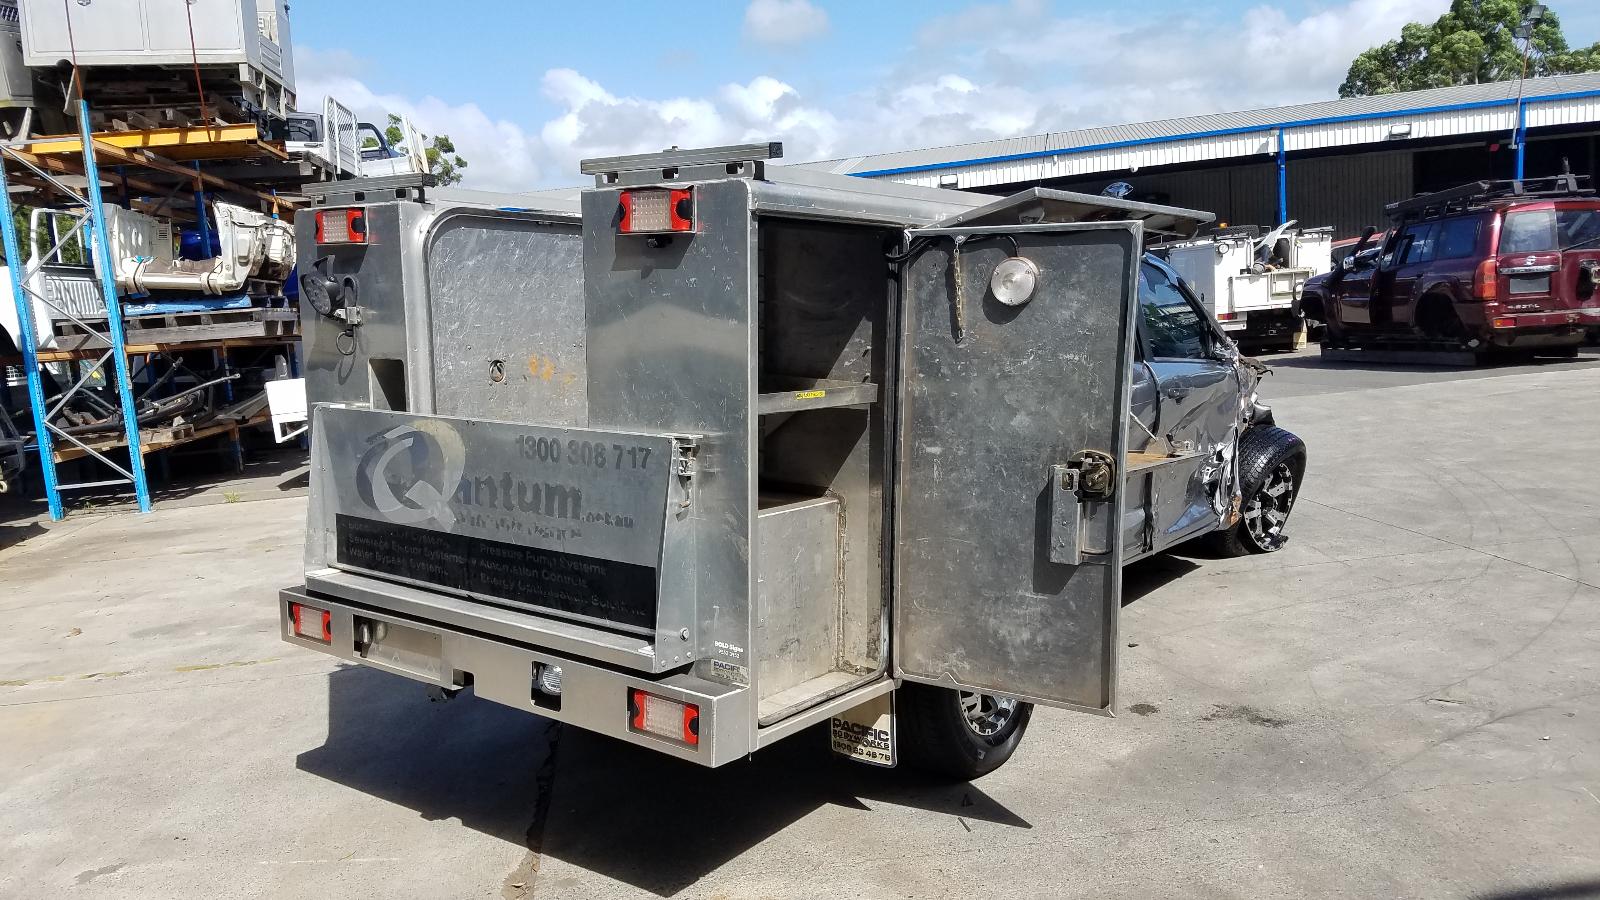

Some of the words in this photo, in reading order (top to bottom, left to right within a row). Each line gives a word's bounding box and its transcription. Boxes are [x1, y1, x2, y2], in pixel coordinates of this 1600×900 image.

[515, 434, 561, 463] 1300
[567, 439, 606, 468] 308
[612, 443, 652, 470] 717
[349, 547, 374, 561] Water
[479, 543, 524, 561] Pressure
[559, 556, 608, 576] Systems
[715, 640, 729, 649] BOLD
[832, 717, 890, 743] PACIFIC
